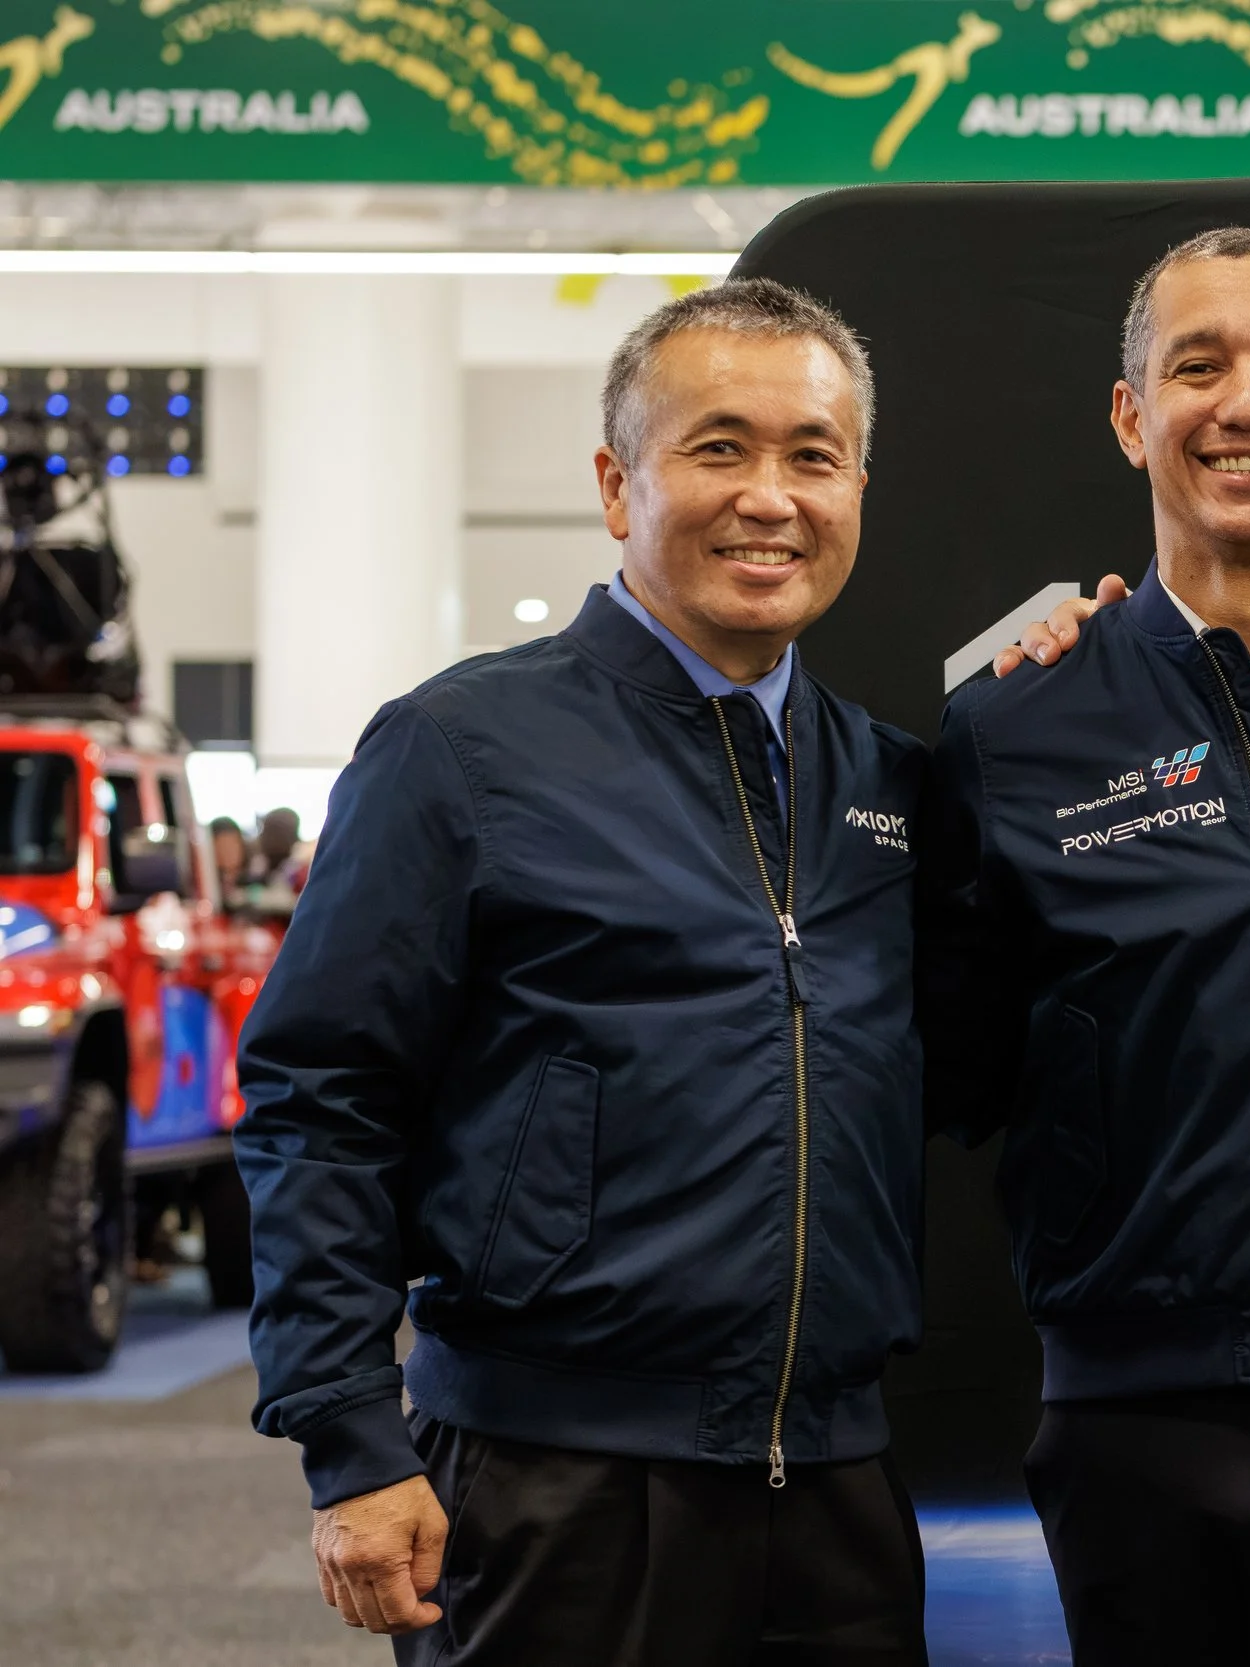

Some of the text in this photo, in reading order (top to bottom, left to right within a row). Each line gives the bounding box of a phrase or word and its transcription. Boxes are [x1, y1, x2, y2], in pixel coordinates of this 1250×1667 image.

[54, 87, 370, 134] AUSTRALIA
[1077, 785, 1147, 813] Performance
[845, 806, 906, 836] AXIOM
[1061, 797, 1226, 856] POWERMOTION
[1201, 816, 1227, 827] GROUP
[874, 835, 909, 852] SPACE
